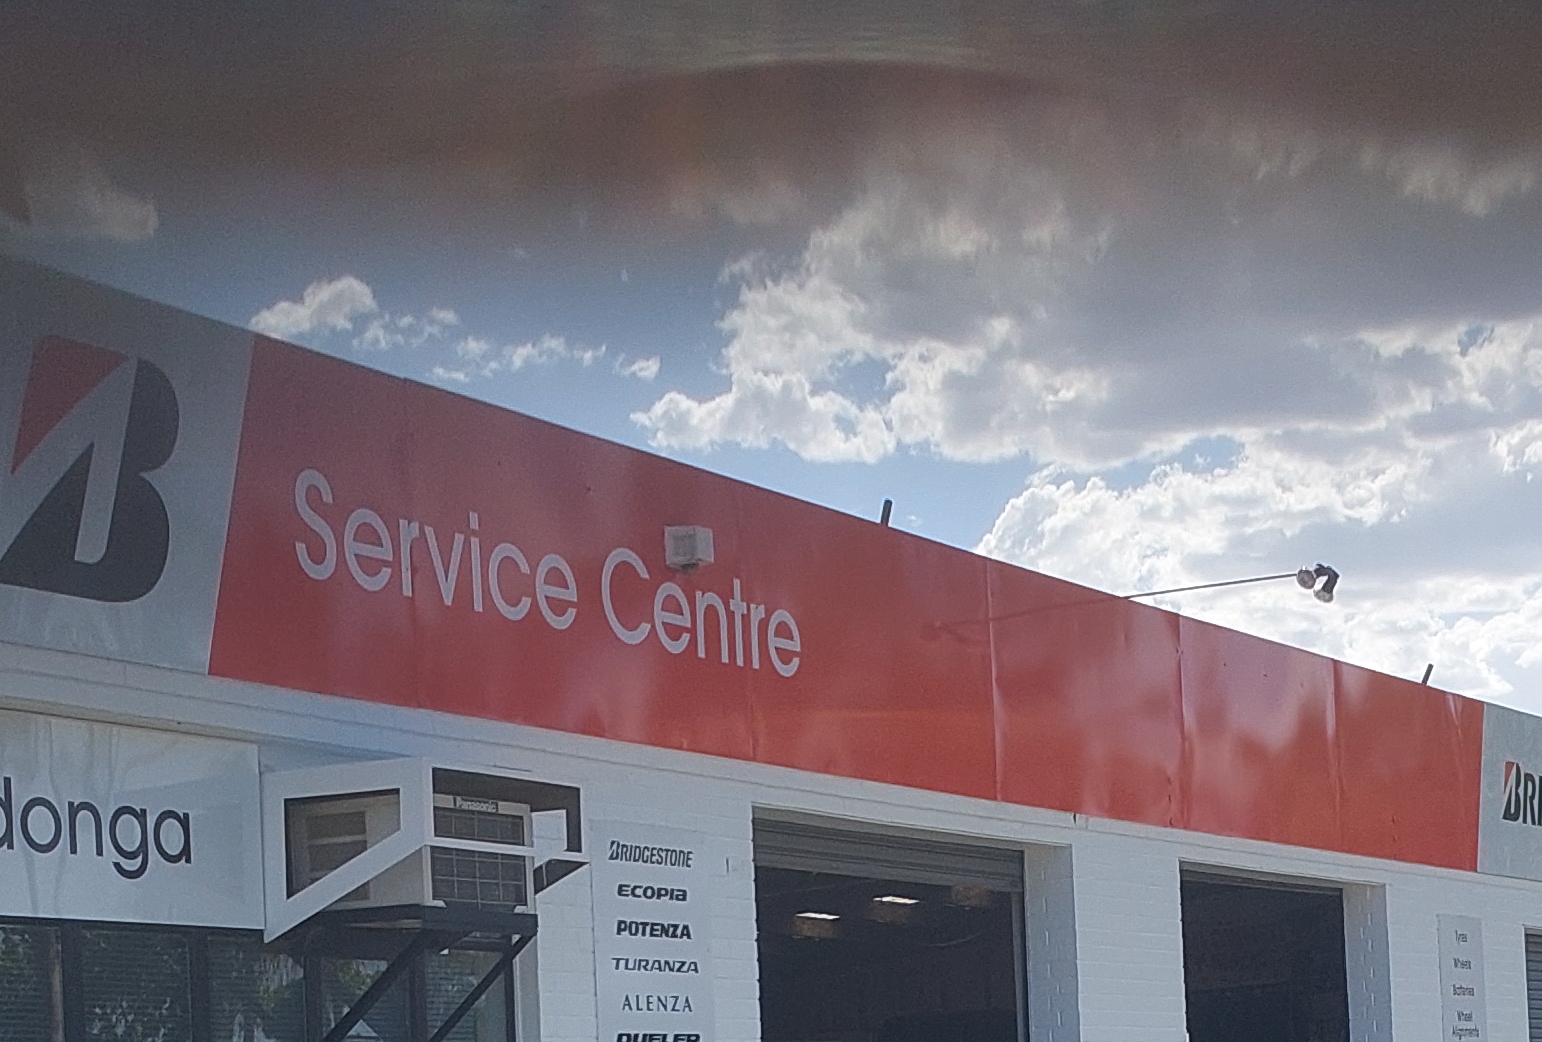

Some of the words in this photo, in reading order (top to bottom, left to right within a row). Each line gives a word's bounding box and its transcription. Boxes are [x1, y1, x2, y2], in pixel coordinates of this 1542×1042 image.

[294, 468, 577, 631] Service
[601, 548, 801, 677] Centre
[609, 840, 694, 868] BRIDGESTONE
[617, 883, 688, 902] ECOPIA
[616, 920, 692, 940] POTENZA
[611, 957, 699, 974] TURANZA
[621, 994, 693, 1013] ALENZA
